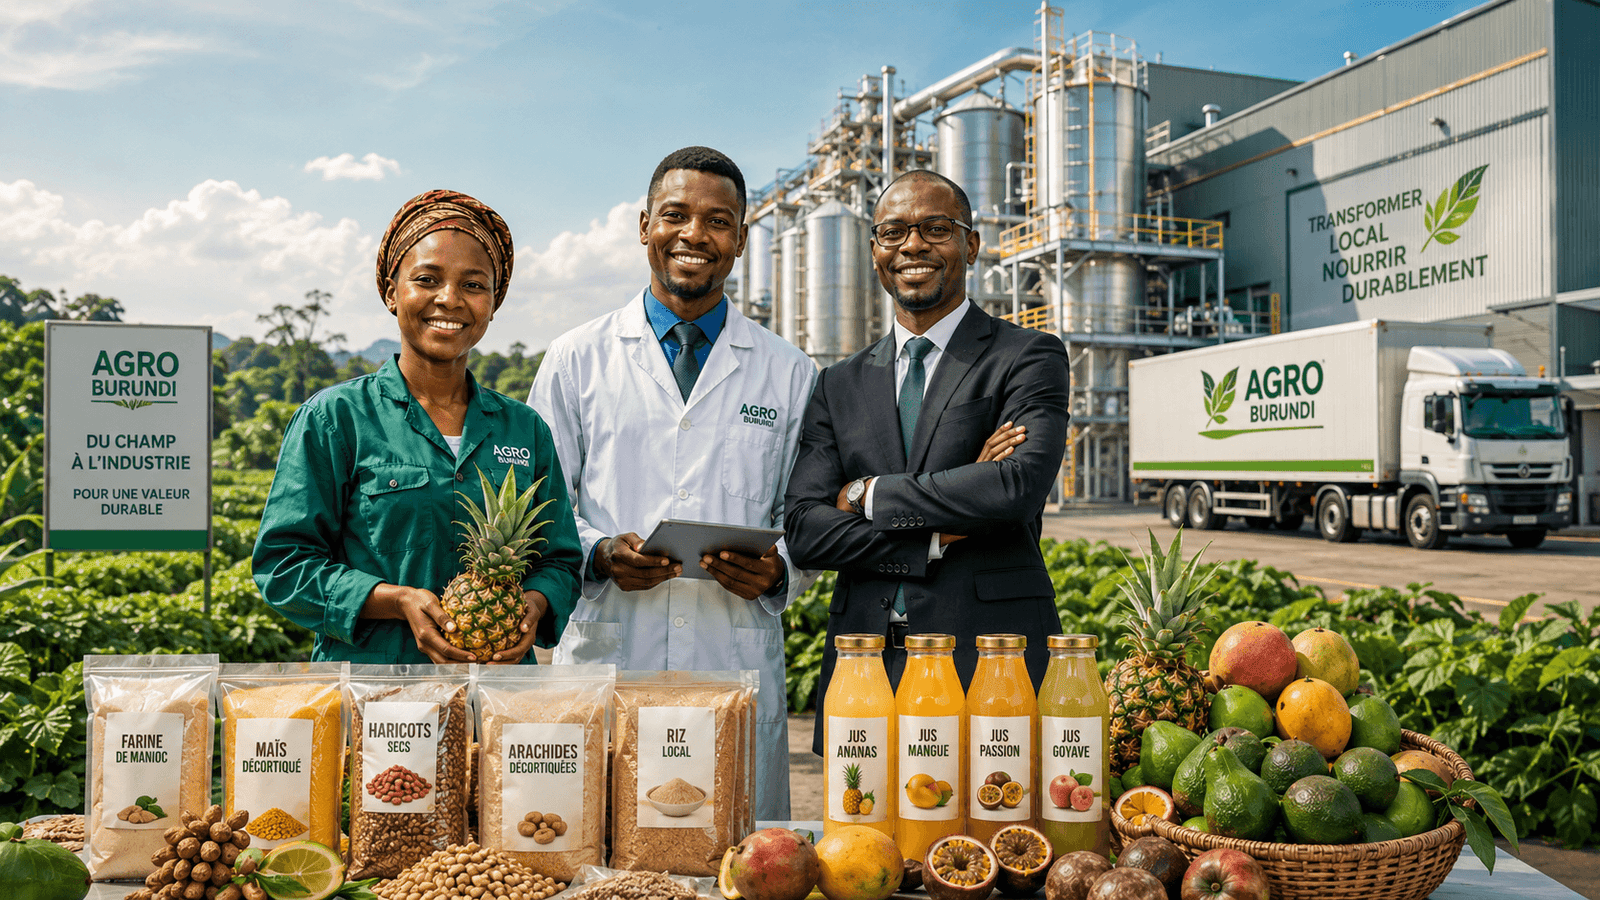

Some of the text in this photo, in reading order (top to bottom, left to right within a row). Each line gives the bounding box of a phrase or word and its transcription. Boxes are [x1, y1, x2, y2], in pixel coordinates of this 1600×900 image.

[1308, 188, 1422, 233] TRANSFORMER
[1329, 222, 1389, 254] LOCAL
[1322, 245, 1406, 282] NOURRIR
[1342, 254, 1488, 304] DURABLEMENT
[92, 350, 179, 378] AGRO
[92, 379, 176, 397] BURUNDI
[1244, 360, 1323, 401] AGRO
[739, 403, 778, 420] AGRO
[1250, 400, 1314, 423] BURUNDI
[86, 434, 176, 449] DU CHAMP
[493, 444, 531, 459] AGRO
[71, 452, 191, 470] À L’INDUSTRIE
[73, 488, 190, 500] POUR UNE VALEUR
[101, 503, 163, 515] DURABLE
[368, 722, 431, 739] HARICOTS
[667, 728, 686, 743] RIZ
[847, 729, 867, 743] JUS
[918, 728, 938, 742] JUS
[990, 728, 1009, 742] JUS
[1061, 729, 1081, 743] JUS
[121, 734, 163, 749] FARINE
[256, 739, 287, 758] MAÏS
[387, 740, 411, 753] SECS
[116, 751, 168, 764] DE MANIOC
[508, 743, 578, 760] ARACHIDES
[662, 745, 691, 758] LOCAL
[836, 745, 878, 759] ANANAS
[907, 744, 950, 757] MANGUE
[979, 744, 1020, 758] PASSION
[1052, 745, 1090, 758] GOYAVE
[242, 758, 302, 774] DÉCORTIQUÉ
[509, 759, 577, 775] DÉCORTIQUÉES
